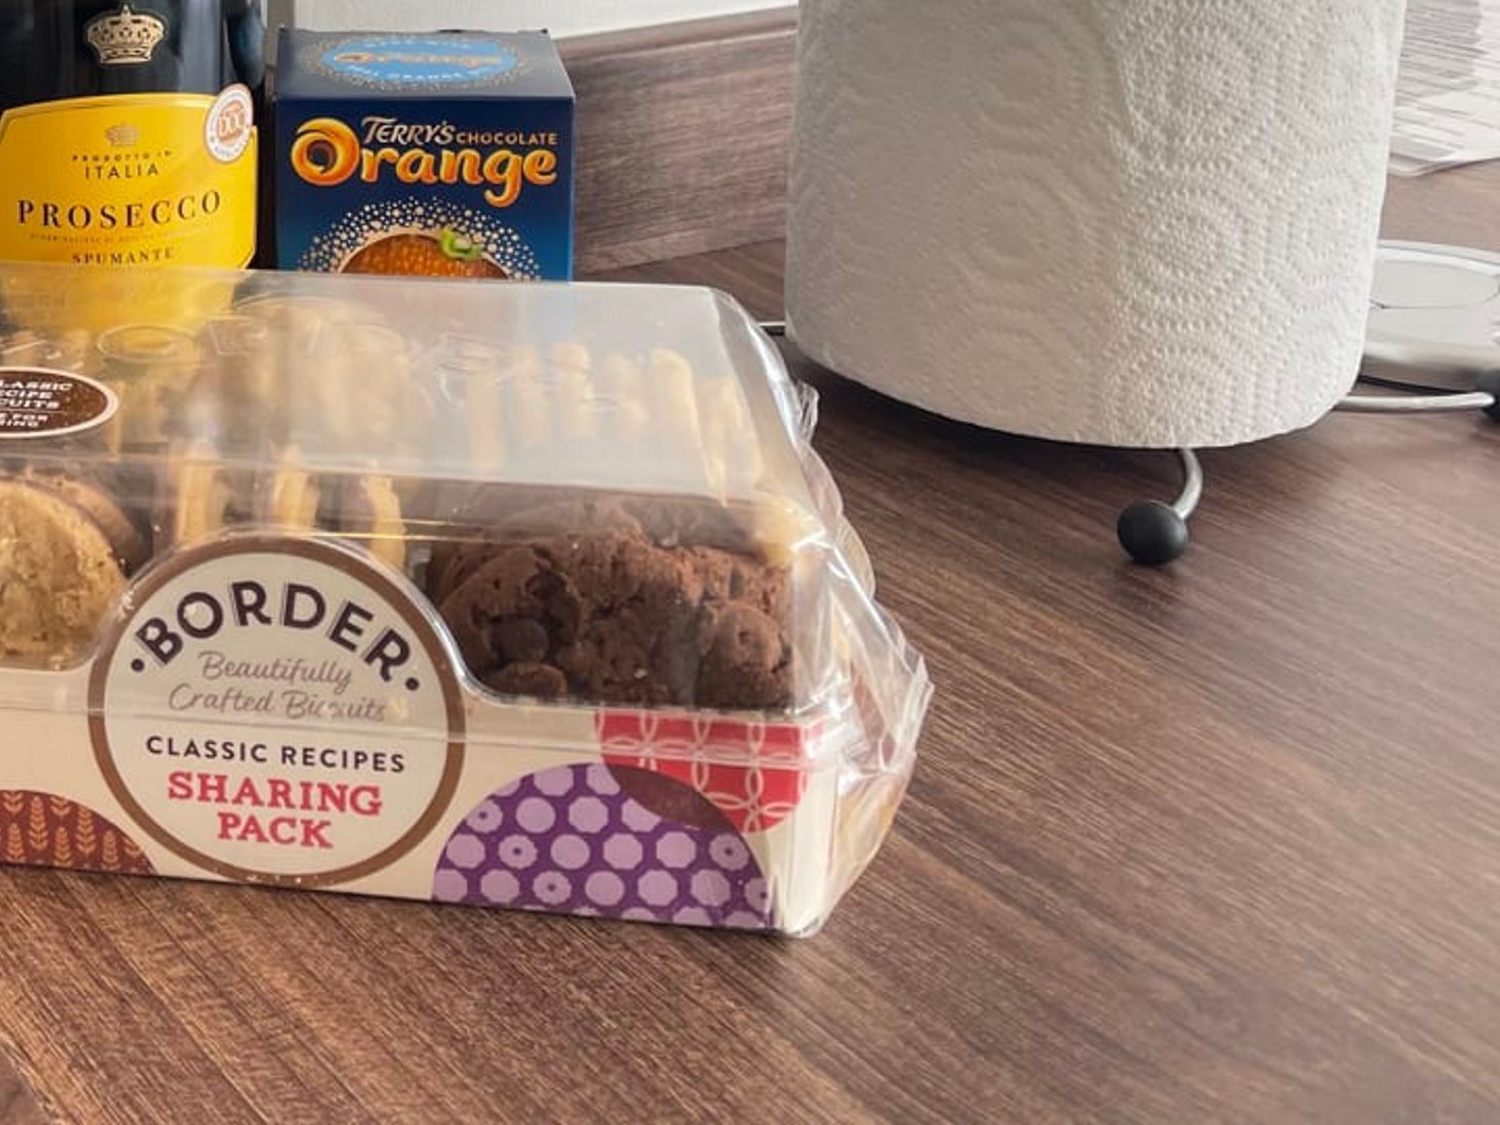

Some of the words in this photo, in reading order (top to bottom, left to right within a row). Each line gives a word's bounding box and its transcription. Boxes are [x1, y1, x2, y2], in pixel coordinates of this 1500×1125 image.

[456, 132, 558, 146] CHOCOLATE
[84, 162, 160, 180] ITALIA
[291, 117, 558, 208] Orange
[16, 189, 221, 230] PROSECCO
[71, 247, 174, 265] SPUMANTE
[199, 650, 354, 695] Beautifully
[168, 682, 276, 713] Crafted
[146, 735, 269, 763] CLASSIC
[280, 744, 406, 774] RECIPES
[167, 770, 384, 817] SHARING
[217, 811, 334, 850] PACK
